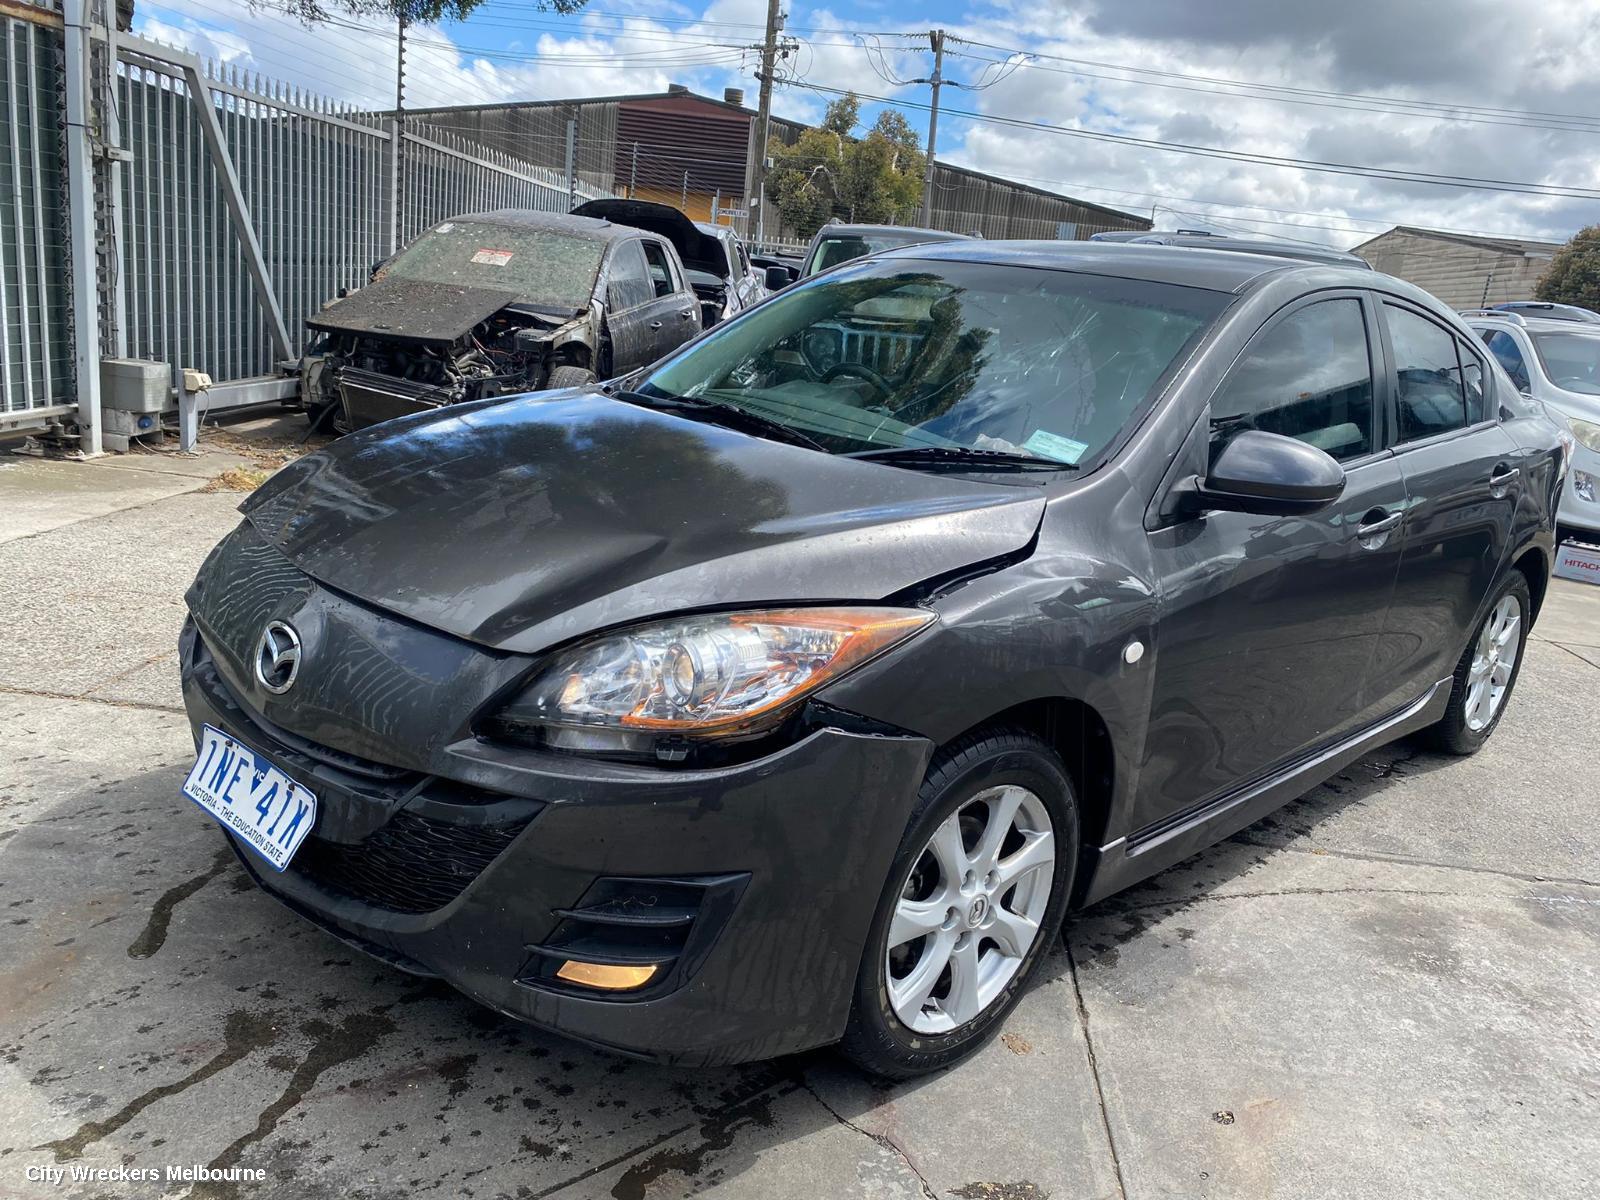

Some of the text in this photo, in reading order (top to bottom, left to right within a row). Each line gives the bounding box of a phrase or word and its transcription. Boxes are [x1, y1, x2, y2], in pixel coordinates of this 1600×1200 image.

[198, 740, 250, 805] 1NE
[191, 784, 217, 811] VICTORIA
[220, 806, 233, 822] THE
[232, 815, 266, 848] EDUCATION
[263, 841, 284, 862] STATE
